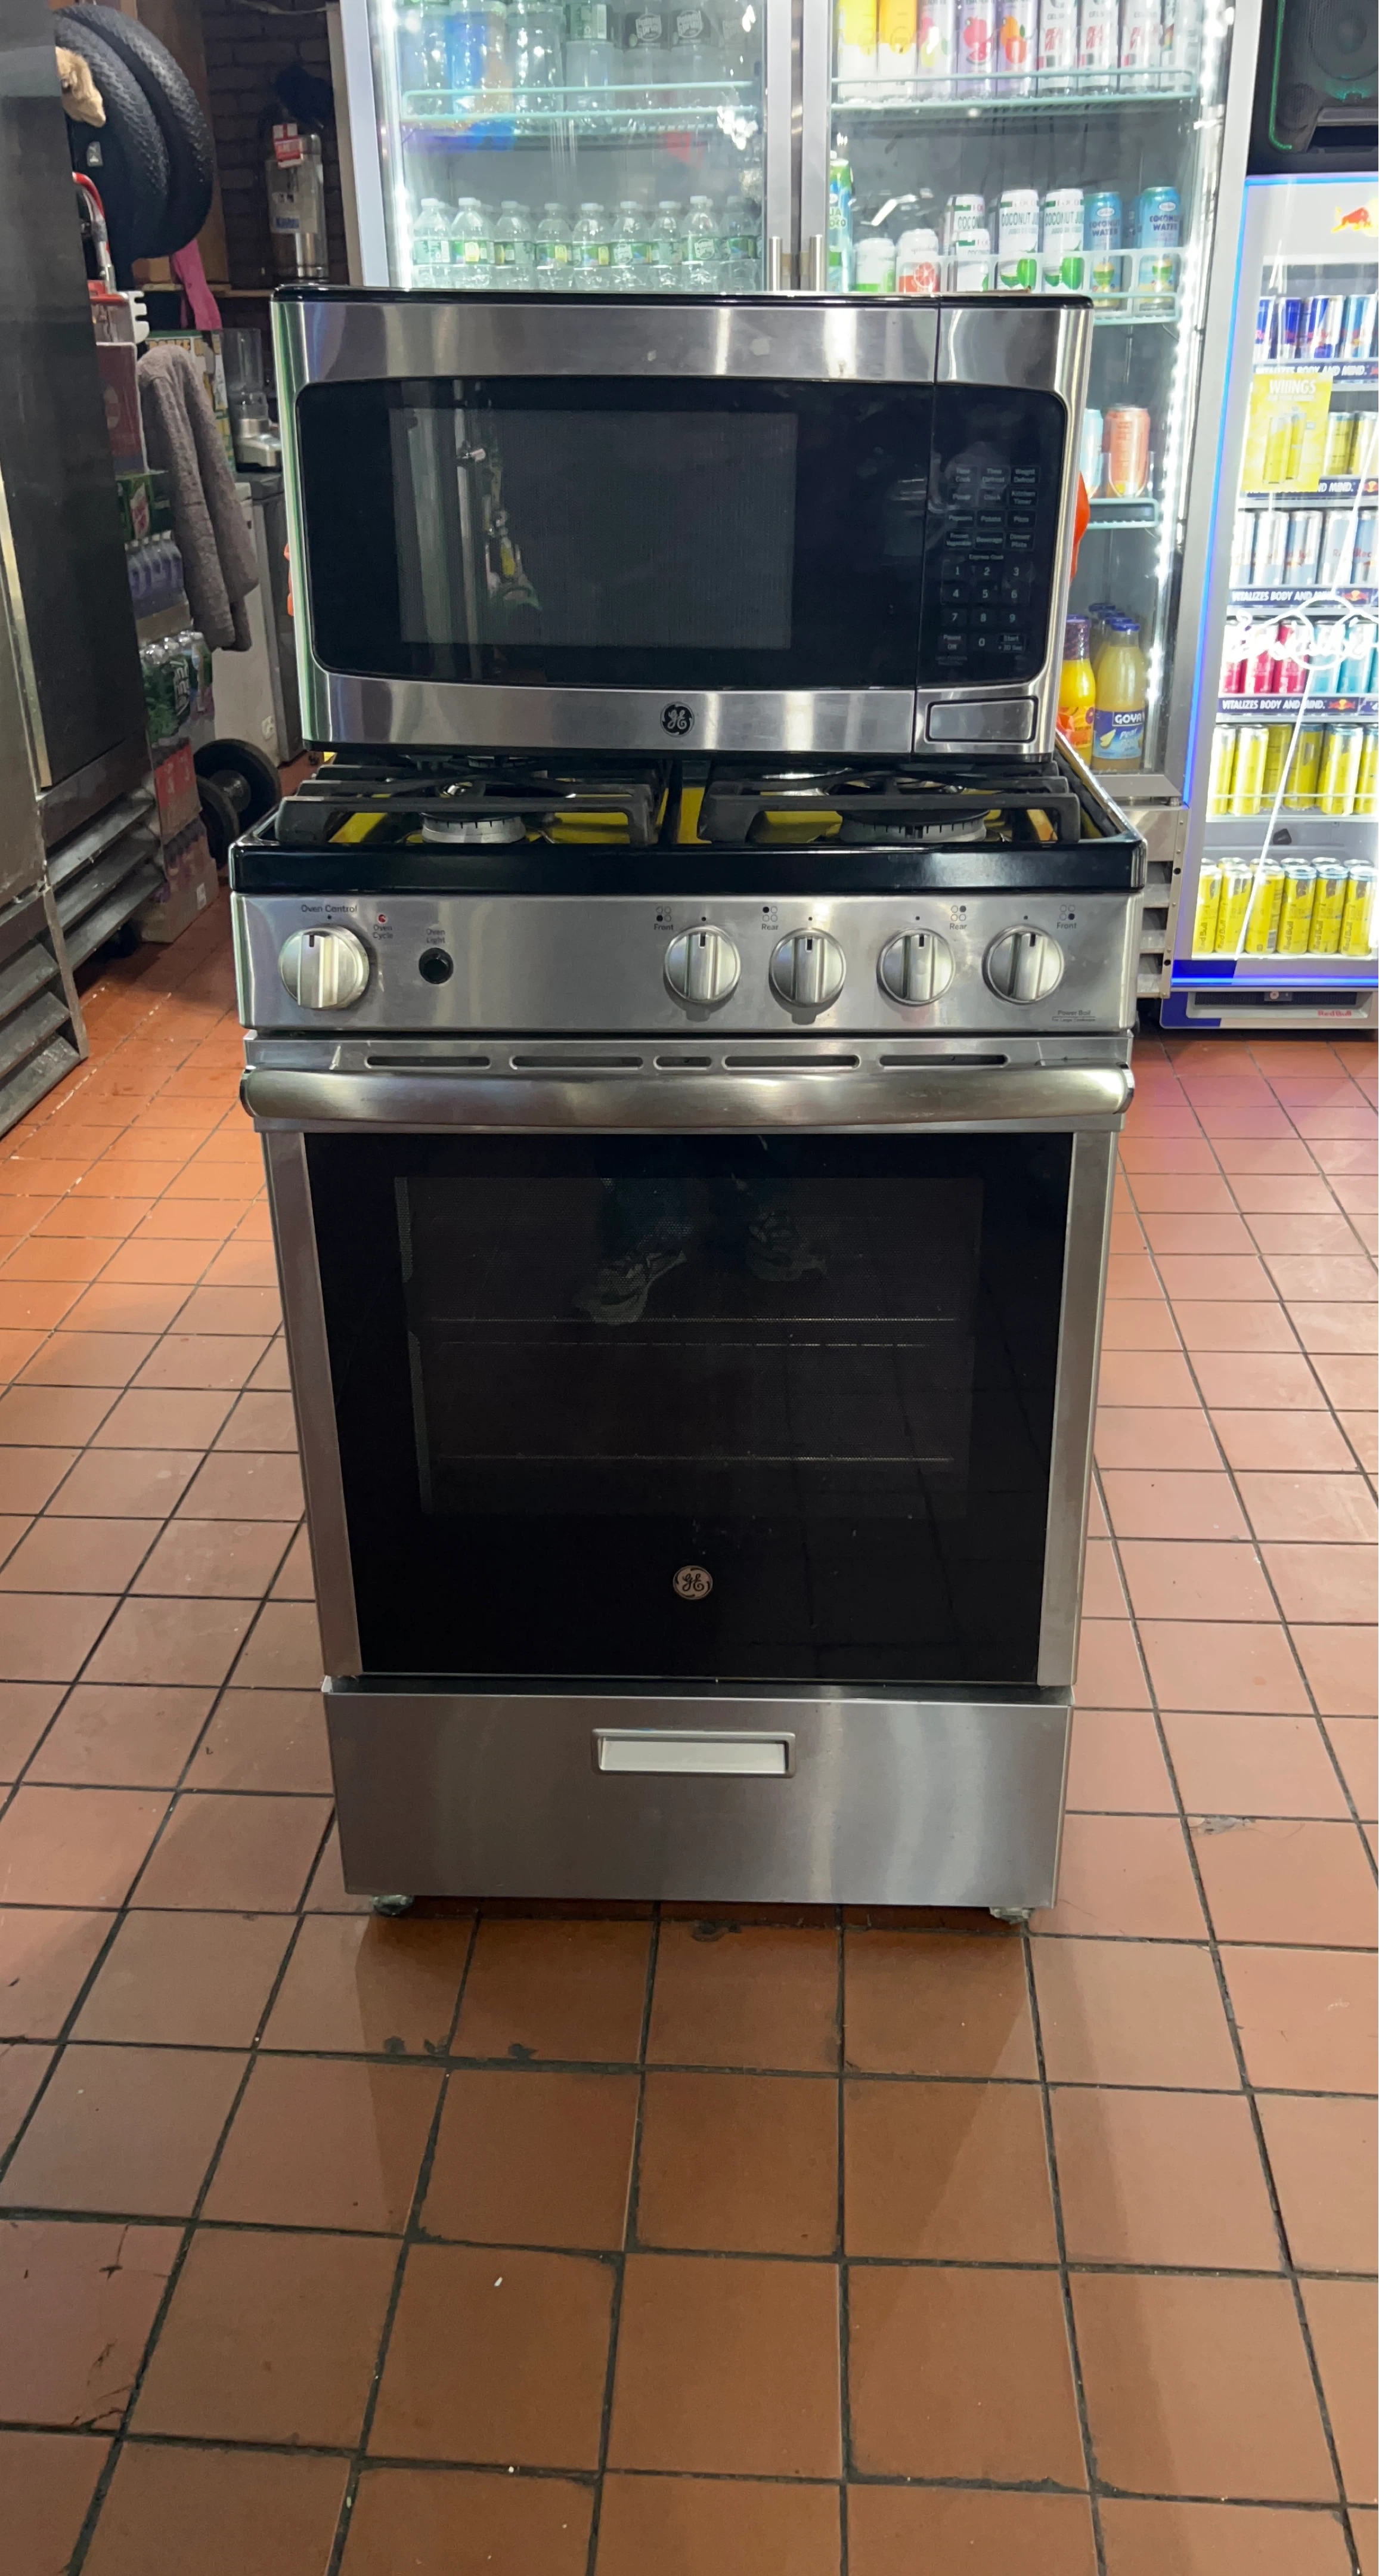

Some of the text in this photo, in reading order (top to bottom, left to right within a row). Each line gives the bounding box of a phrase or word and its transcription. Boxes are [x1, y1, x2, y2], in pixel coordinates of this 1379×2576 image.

[1001, 212, 1031, 227] COCONUT
[1045, 211, 1074, 227] COCONUT
[955, 566, 960, 576] 1
[984, 566, 990, 576] 2
[1013, 566, 1019, 576] 3
[953, 589, 959, 598] 4
[983, 589, 988, 599] 5
[1011, 590, 1018, 599] 6
[1232, 591, 1269, 601] VITALIZES
[1270, 591, 1293, 601] BODY
[1294, 591, 1313, 600] AND
[952, 613, 959, 622] 7
[980, 613, 987, 623] 8
[1009, 614, 1016, 623] 9
[978, 637, 986, 647] 0
[1222, 699, 1258, 710] VITALIZES
[1260, 699, 1282, 710] BODY
[1282, 699, 1300, 710] AND
[1114, 712, 1142, 724] GOYA
[300, 904, 357, 913] Oven Control
[426, 936, 446, 945] Light
